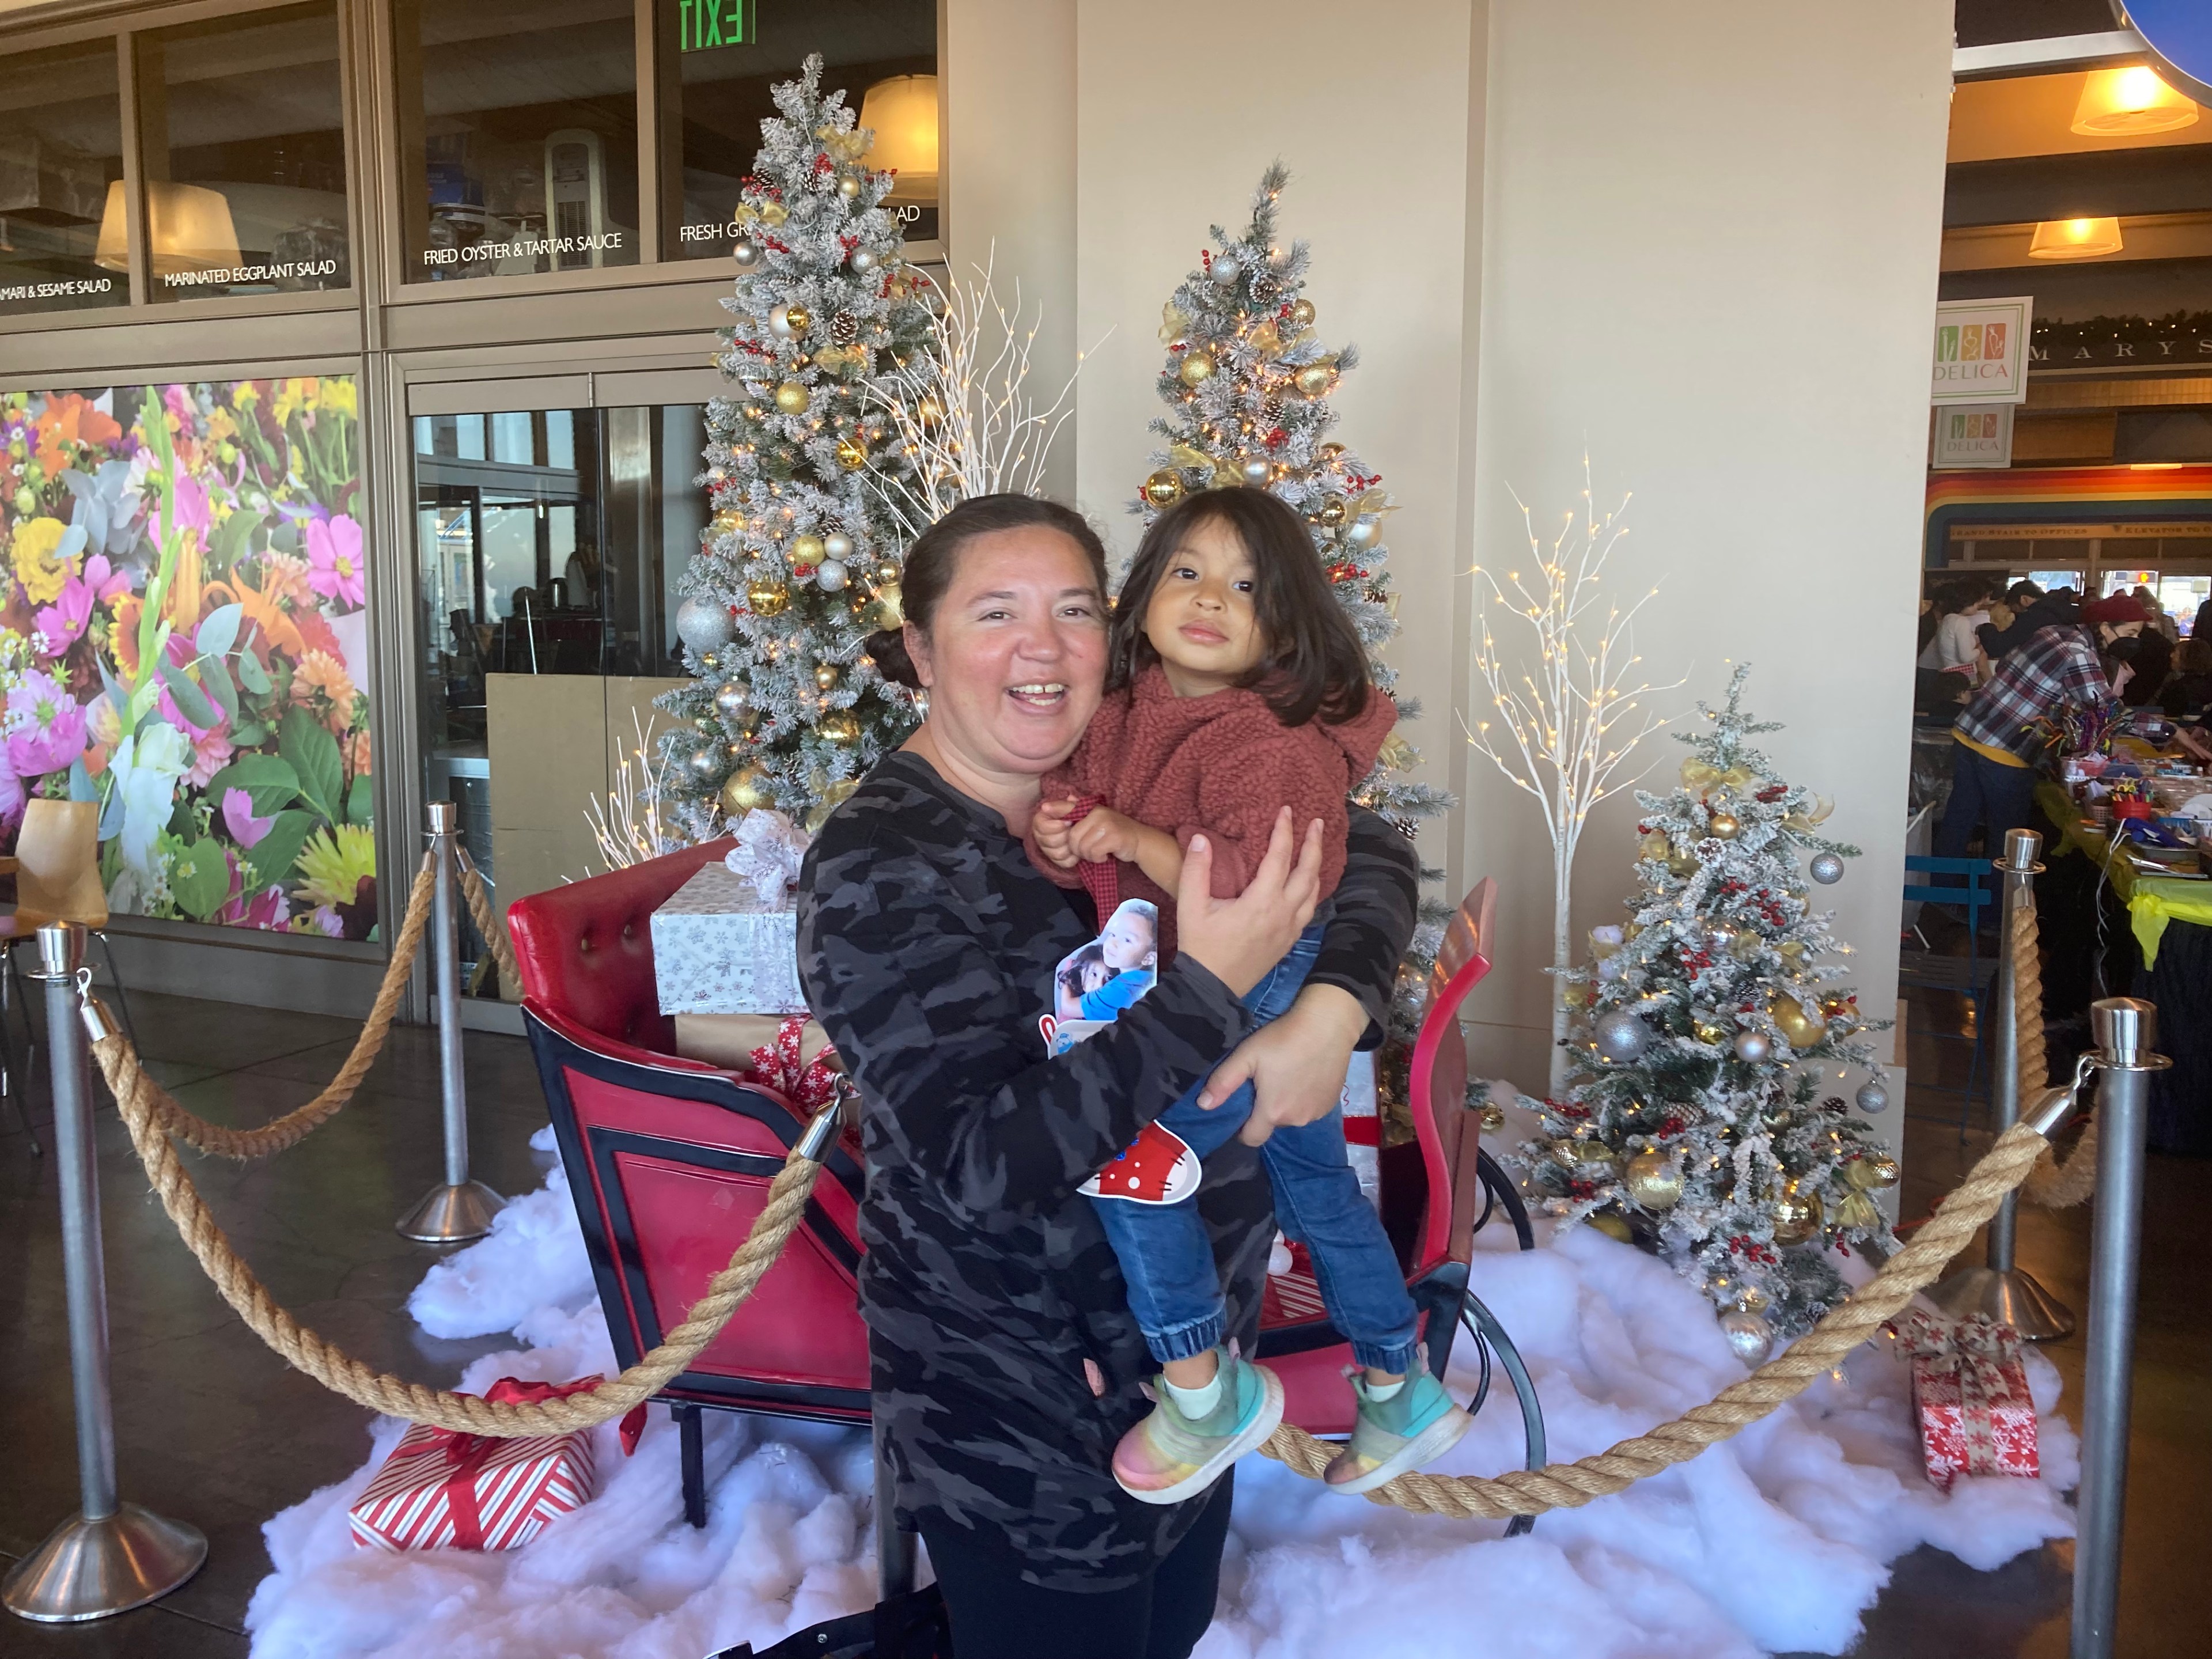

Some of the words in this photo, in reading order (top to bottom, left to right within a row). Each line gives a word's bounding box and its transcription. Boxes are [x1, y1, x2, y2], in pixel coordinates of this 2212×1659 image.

[888, 205, 920, 221] AD
[680, 223, 722, 242] FRESH
[727, 222, 751, 237] GR
[424, 250, 458, 265] FRIED
[461, 243, 510, 262] OYSTER
[513, 243, 523, 257] &
[524, 237, 574, 256] TARTAR
[577, 233, 622, 251] SAUCE
[165, 268, 230, 287] MARINATED
[233, 263, 294, 282] EGGPLANT
[297, 260, 336, 276] SALAD
[28, 285, 36, 298] &
[37, 281, 75, 297] SESAME
[77, 278, 112, 294] SALAD
[1933, 363, 2008, 381] DELICA
[1947, 441, 1999, 452] DELICA
